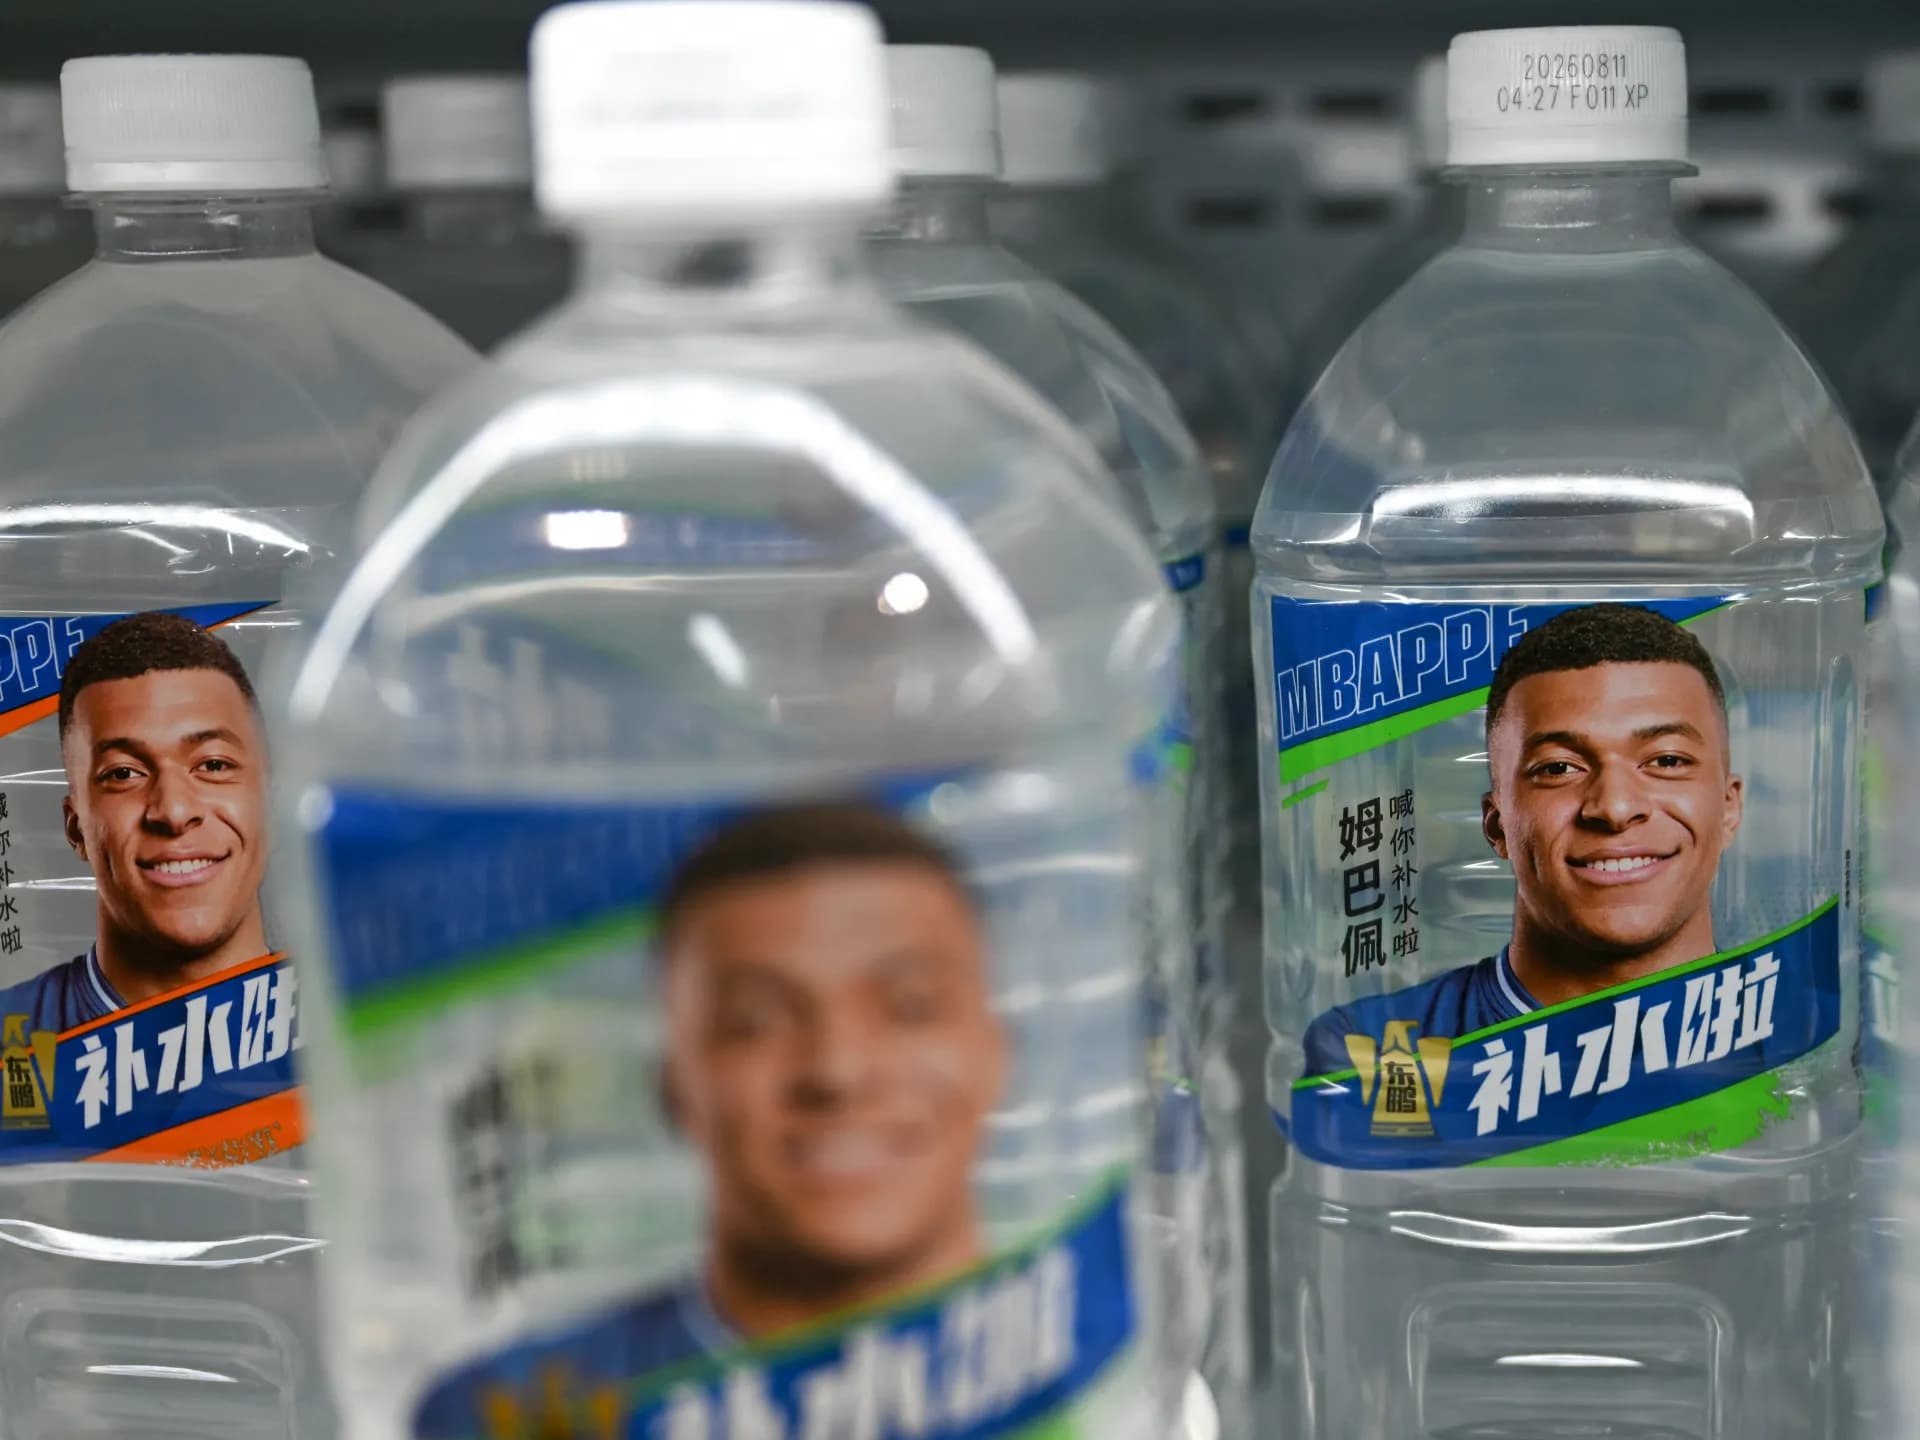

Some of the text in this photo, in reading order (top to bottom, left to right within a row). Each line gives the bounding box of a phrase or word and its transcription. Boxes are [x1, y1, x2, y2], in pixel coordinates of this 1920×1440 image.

[1524, 54, 1627, 80] 20260811
[1498, 85, 1560, 112] 04:27
[1624, 83, 1649, 109] XP
[1339, 797, 1387, 978] 姆巴佩
[1389, 789, 1421, 957] 喊你补水啦
[1467, 952, 1781, 1137] 补水啦
[5, 1056, 36, 1109] 东鹏
[1384, 1061, 1418, 1113] 东鹏
